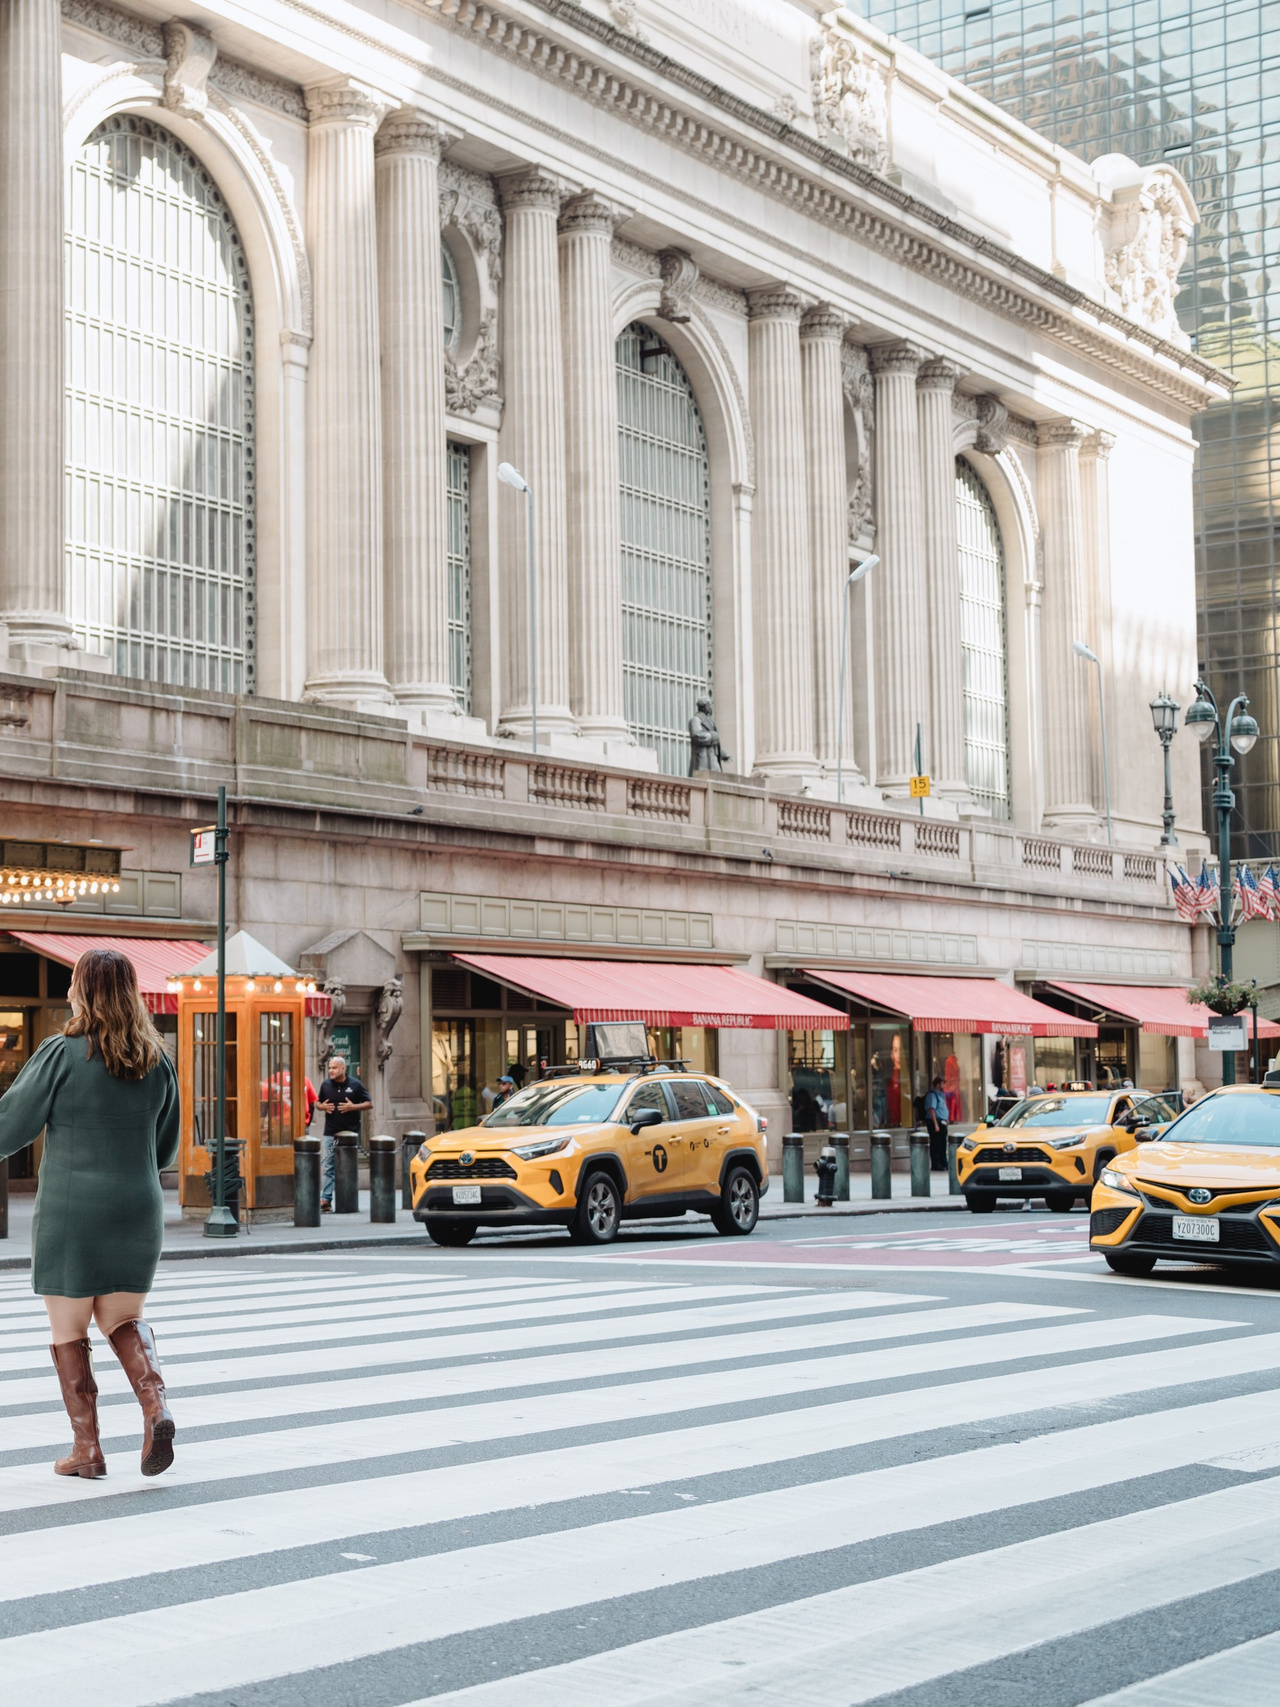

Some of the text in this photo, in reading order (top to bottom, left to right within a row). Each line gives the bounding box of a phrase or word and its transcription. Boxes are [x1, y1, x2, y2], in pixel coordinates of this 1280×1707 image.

[913, 778, 927, 789] 15
[692, 1013, 753, 1027] BANANA REPUBLIC
[330, 1034, 349, 1045] Grand
[1176, 1222, 1215, 1236] Y207300C
